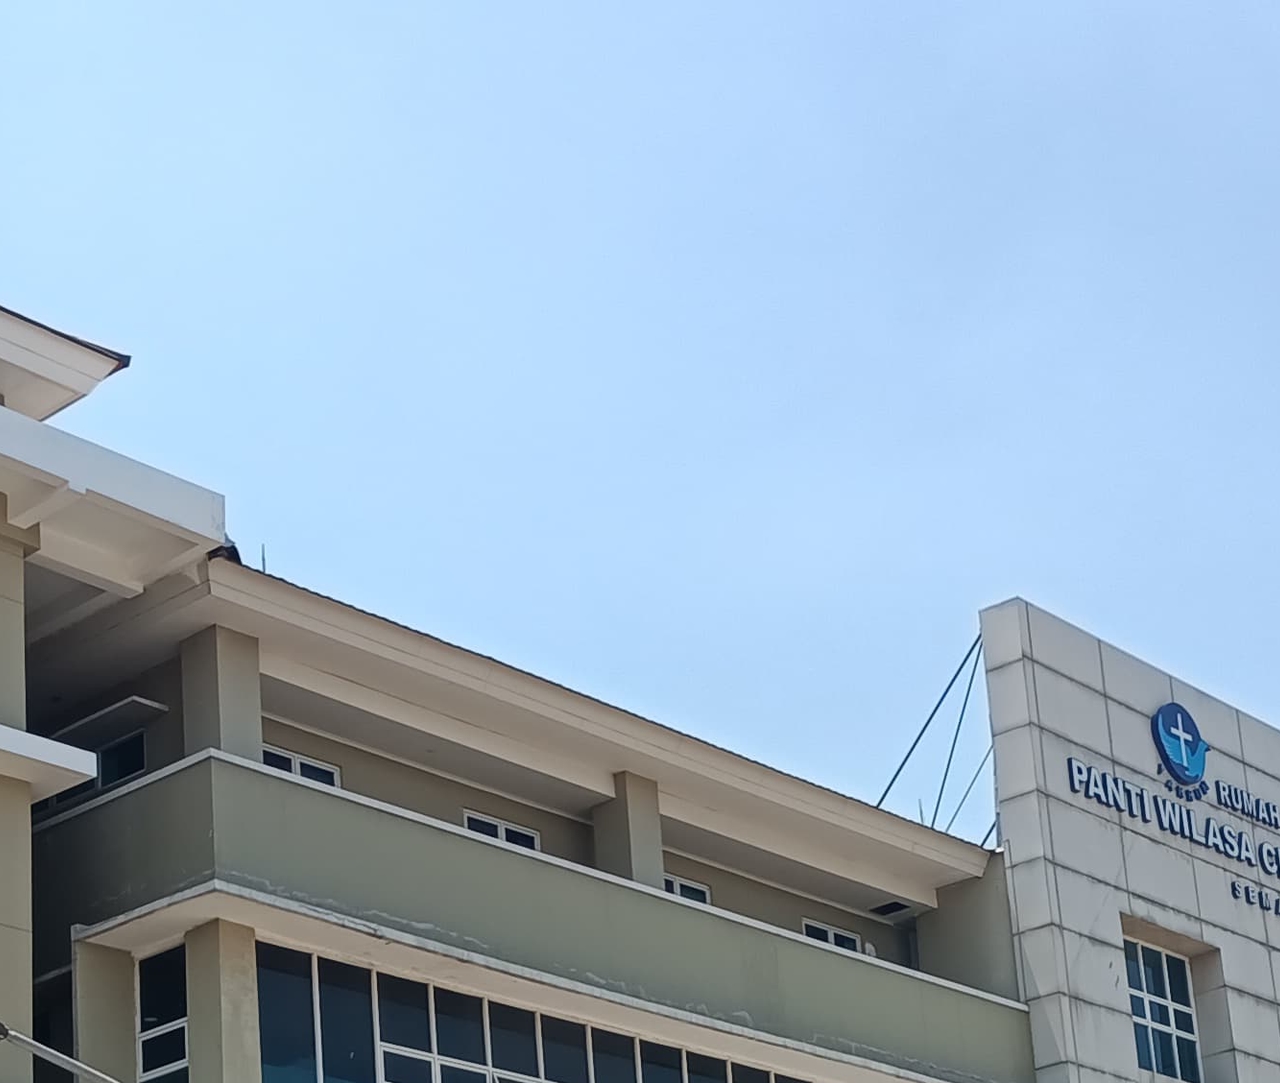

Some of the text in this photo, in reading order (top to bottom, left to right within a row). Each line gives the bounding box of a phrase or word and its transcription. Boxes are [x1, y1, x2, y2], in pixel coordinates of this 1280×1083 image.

[1067, 757, 1151, 823] PANTI
[1153, 794, 1257, 866] WILASA
[1215, 779, 1280, 829] RUMAH
